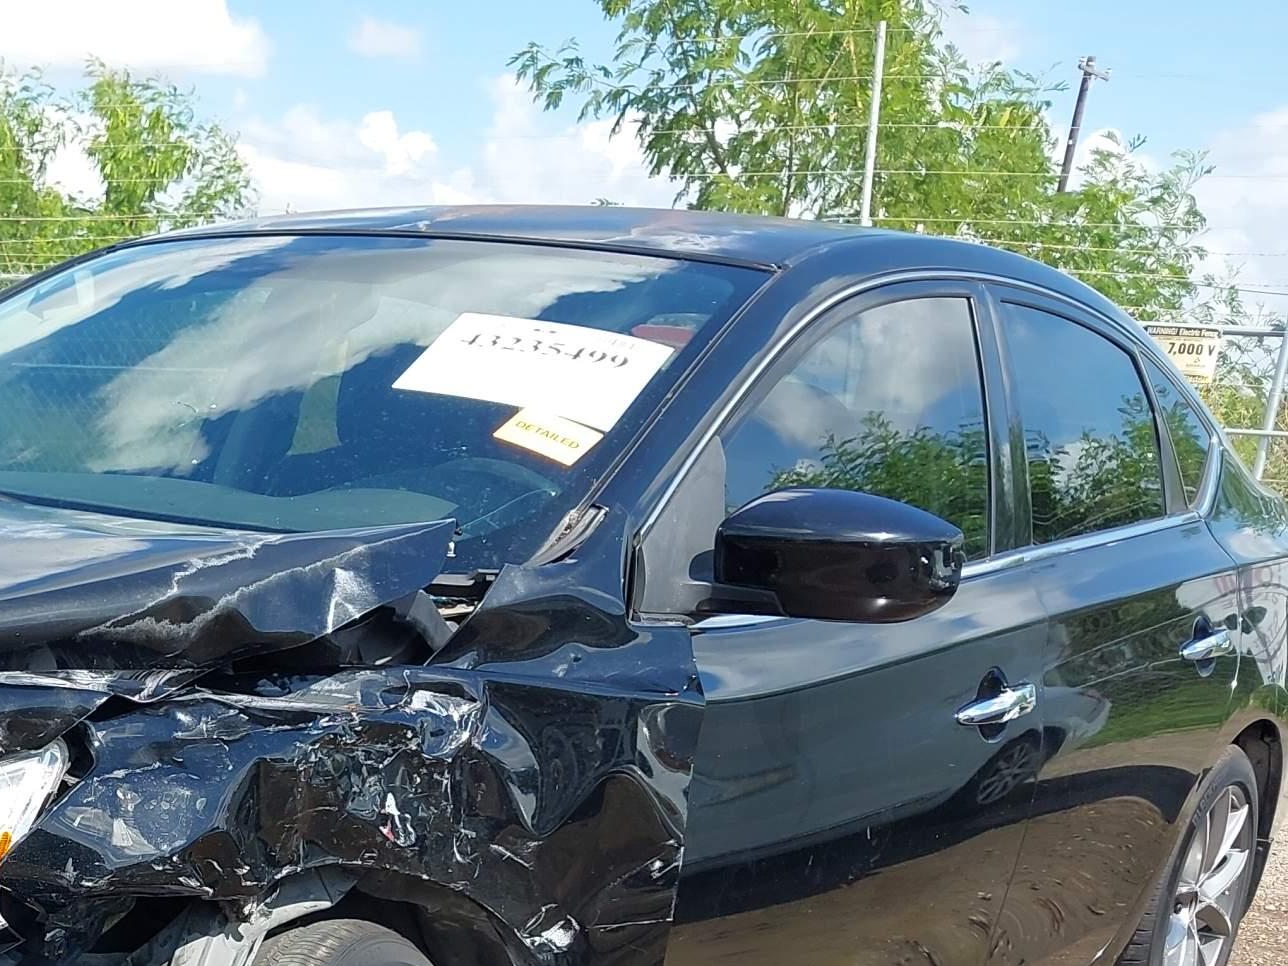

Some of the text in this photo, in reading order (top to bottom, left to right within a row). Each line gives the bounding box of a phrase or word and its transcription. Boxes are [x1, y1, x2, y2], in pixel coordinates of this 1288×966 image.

[1179, 328, 1201, 337] Electric
[459, 333, 630, 369] 43235499
[1167, 342, 1216, 356] 7,000 V
[514, 419, 581, 450] DETAILED
